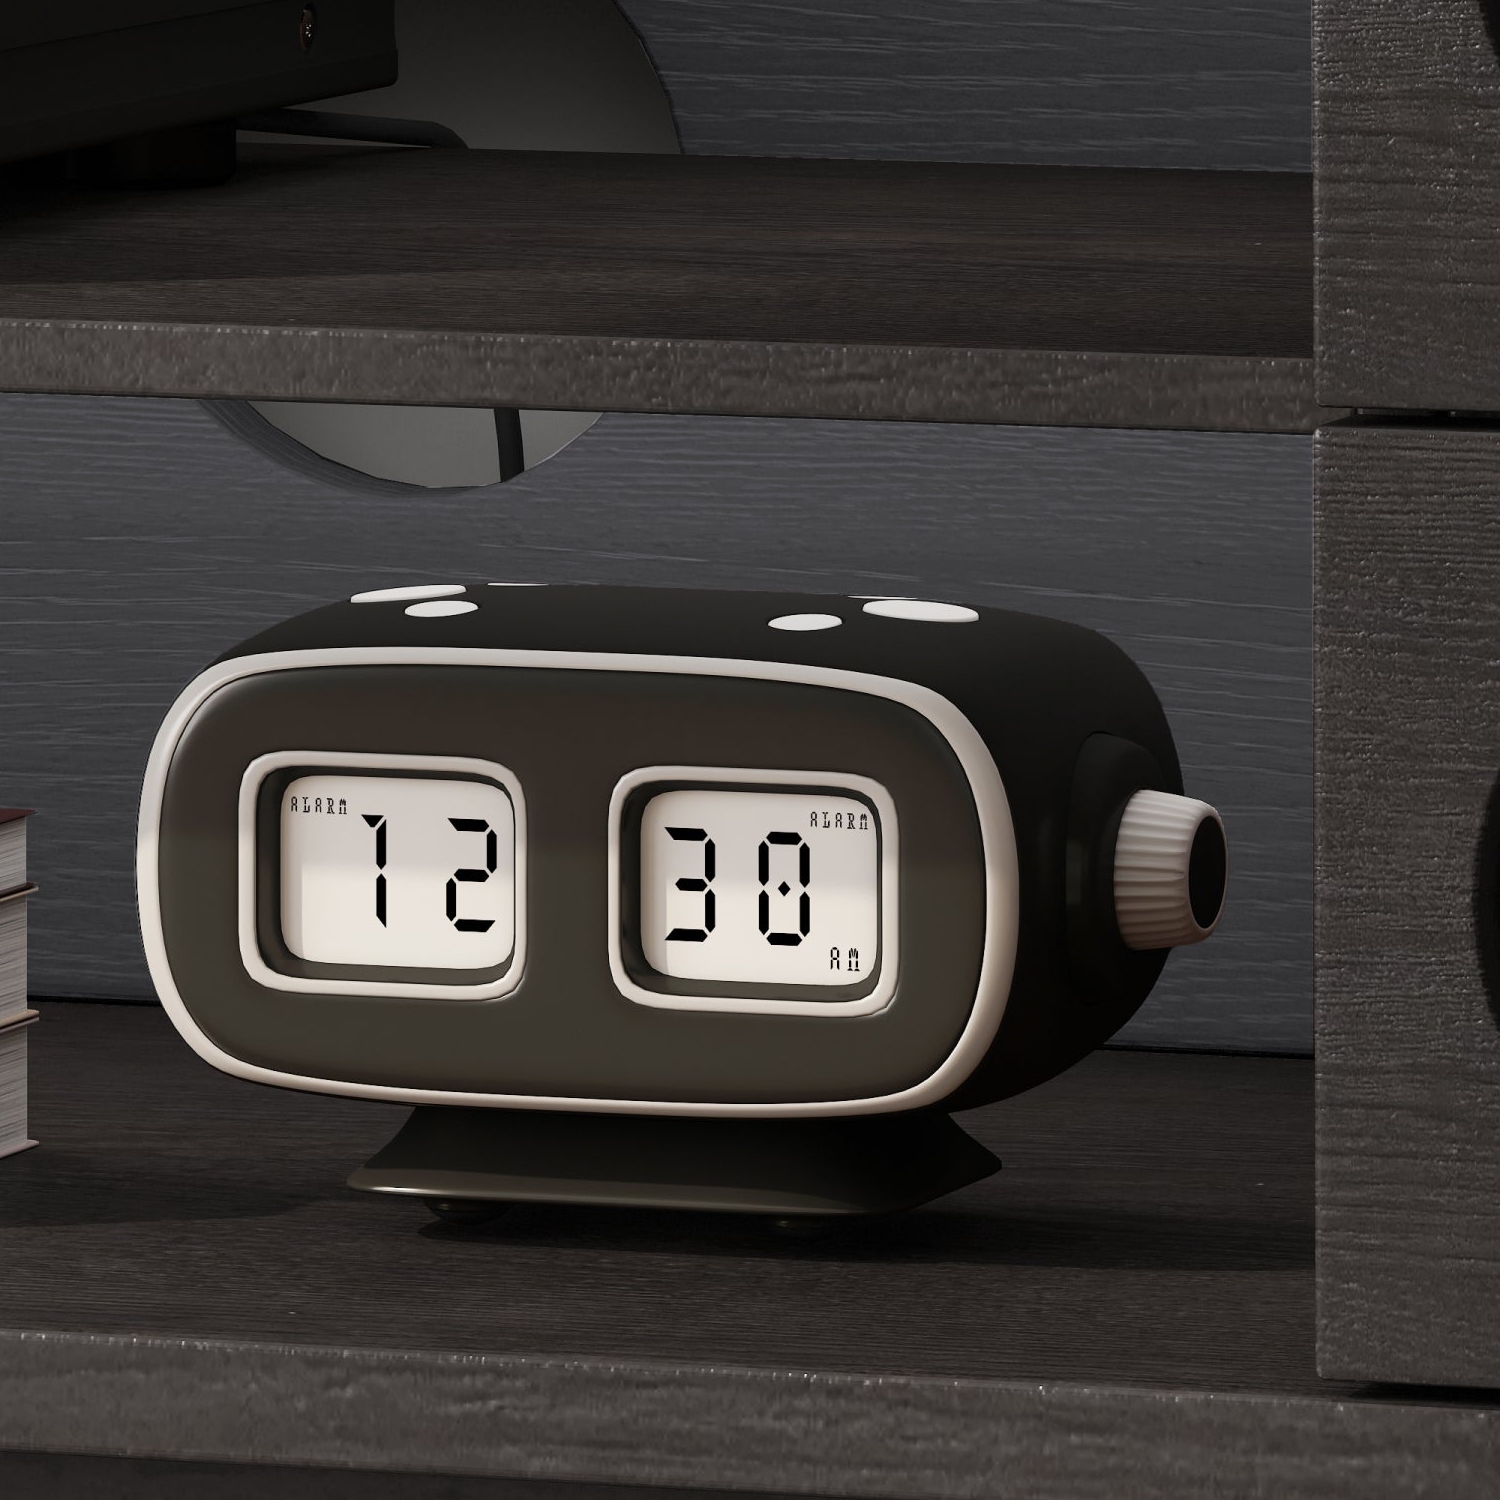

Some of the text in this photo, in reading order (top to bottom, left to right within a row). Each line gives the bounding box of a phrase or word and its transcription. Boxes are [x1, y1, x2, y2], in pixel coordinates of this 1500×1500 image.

[290, 795, 348, 815] ALARM
[810, 811, 869, 831] ALARM
[830, 946, 861, 972] AM
